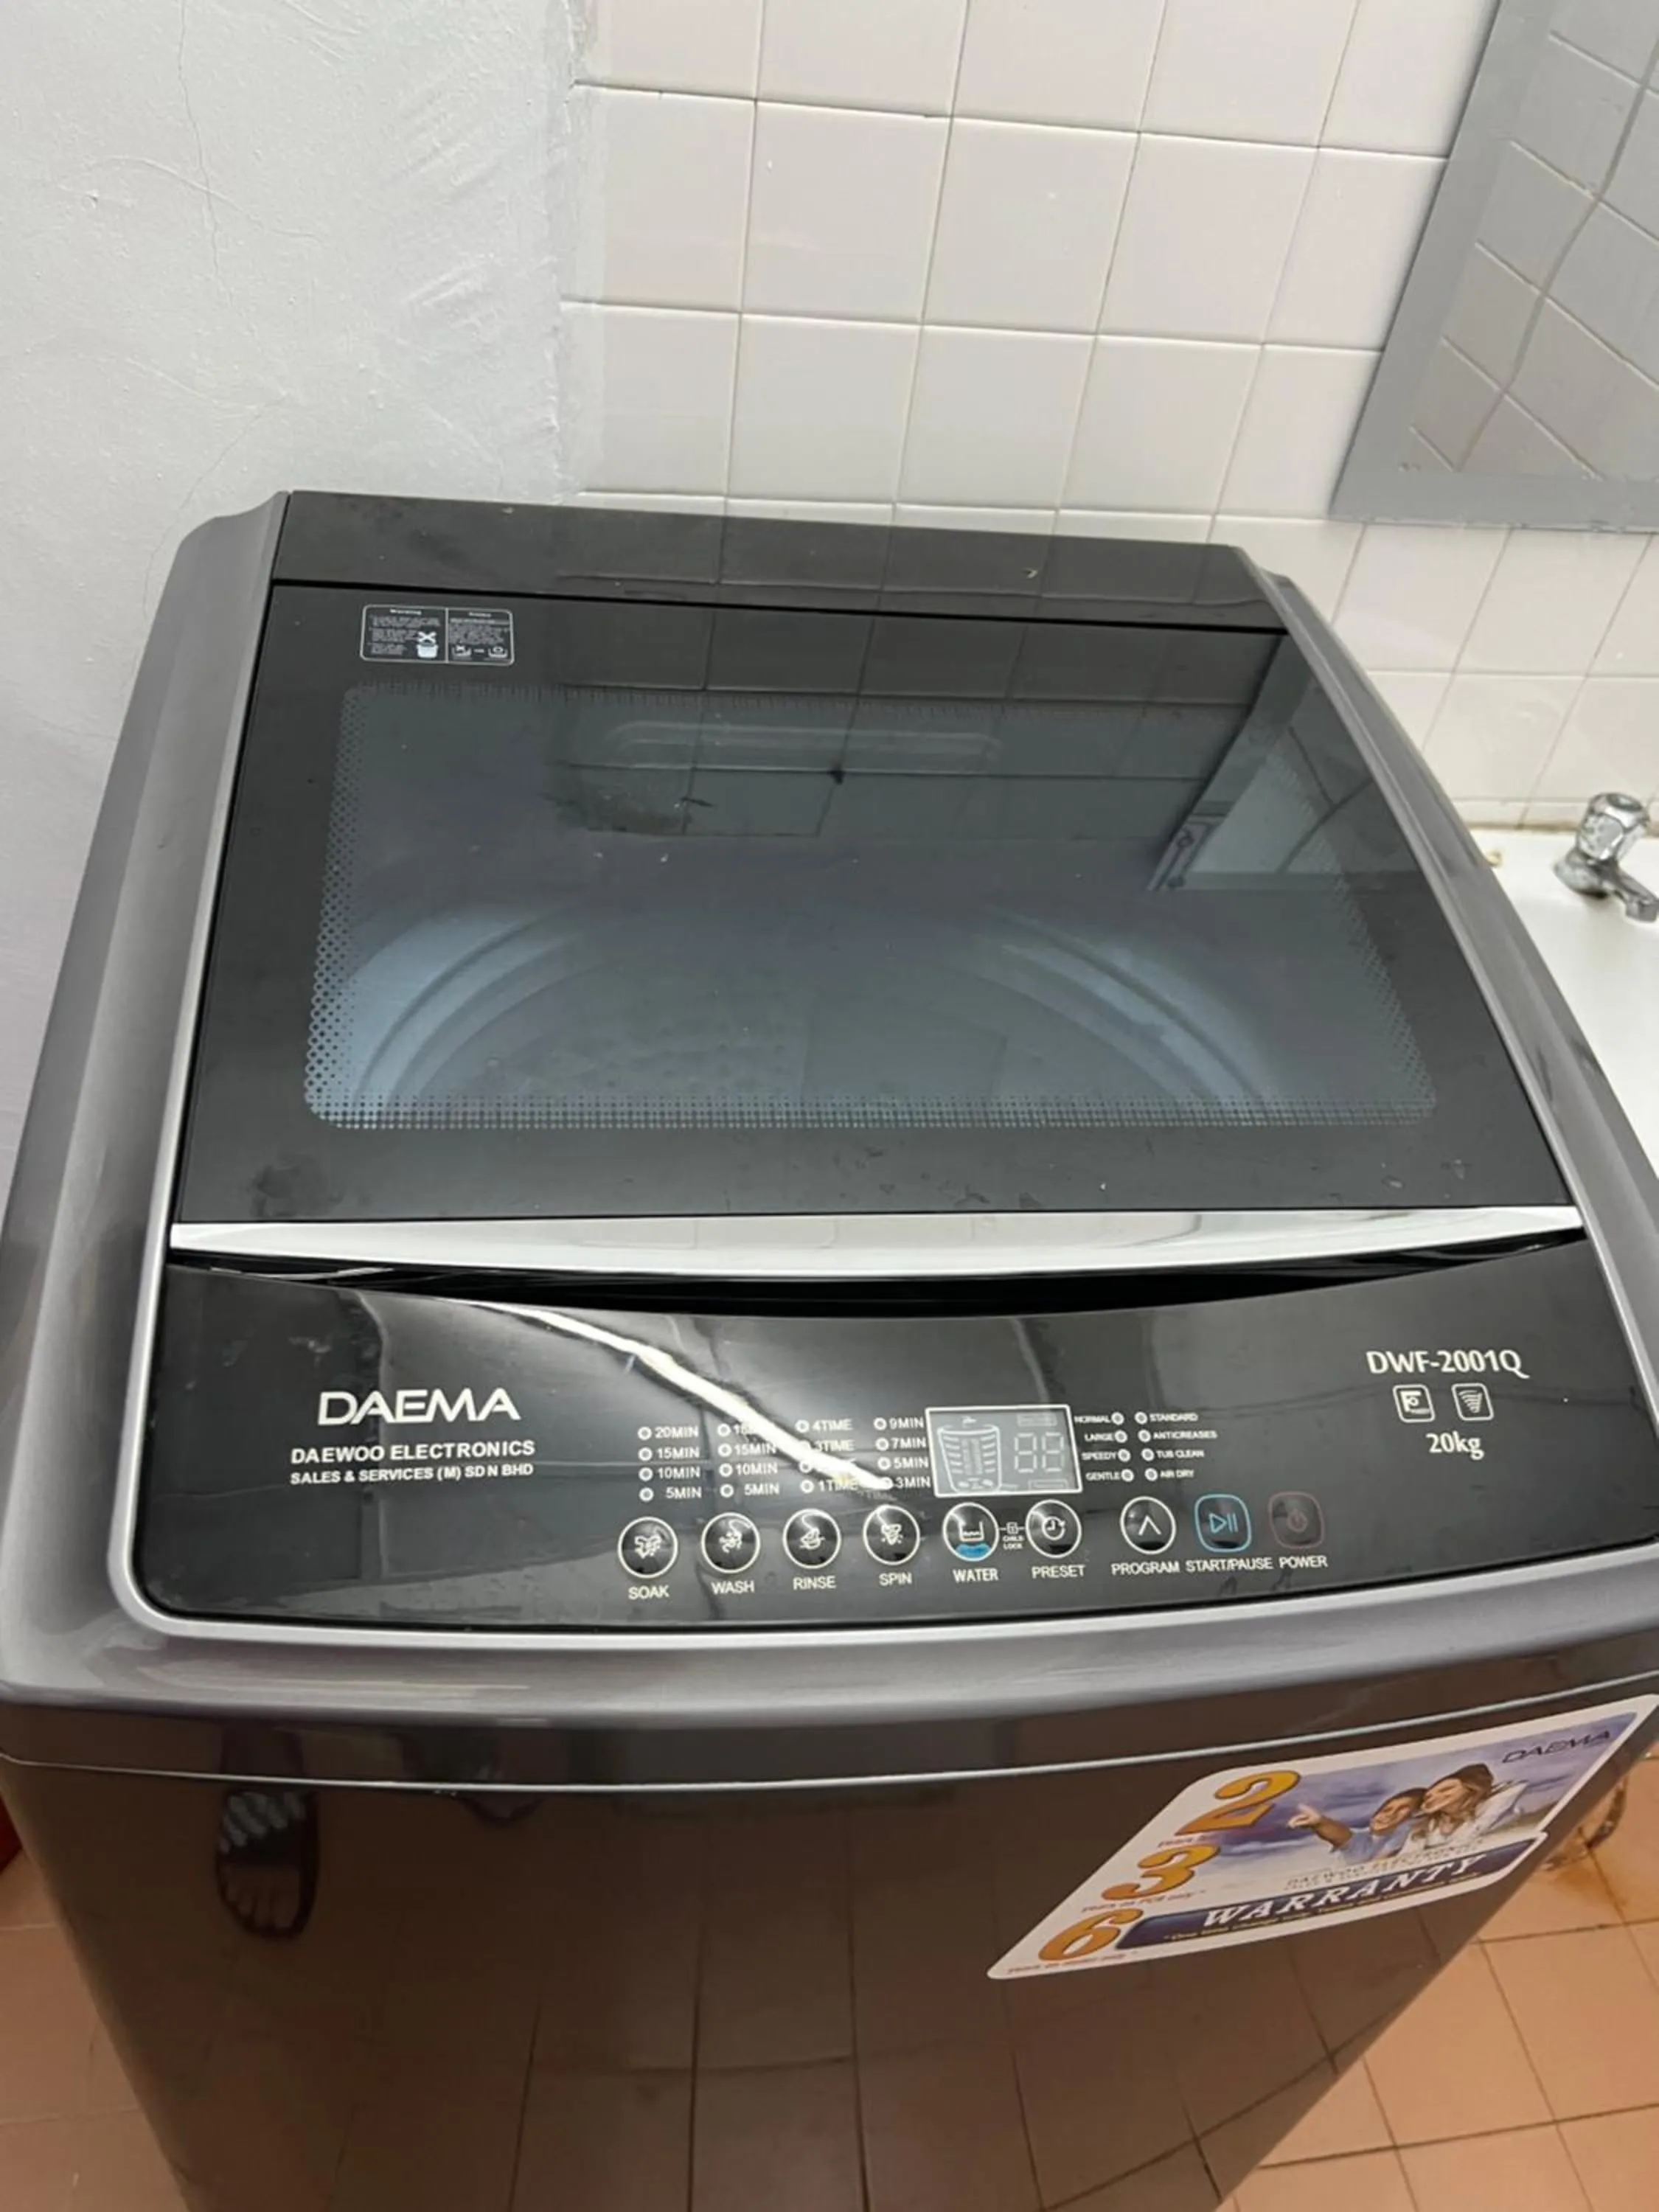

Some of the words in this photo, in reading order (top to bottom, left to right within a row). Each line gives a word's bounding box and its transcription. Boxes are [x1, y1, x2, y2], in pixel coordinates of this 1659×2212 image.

[1366, 1349, 1530, 1379] DWF-2001Q
[318, 1387, 521, 1425] DAEMA
[888, 1416, 924, 1429] 9MIN
[1074, 1415, 1111, 1424] NORMAL
[1150, 1412, 1199, 1422] STANDARD
[812, 1419, 853, 1432] 4TIME
[655, 1426, 699, 1439] 20MIN
[1152, 1430, 1218, 1439] ANTICREASES
[734, 1444, 776, 1456] 15MIN
[891, 1437, 926, 1450] 7MIN
[1425, 1430, 1485, 1460] 20kg
[291, 1445, 385, 1464] DAEWOO
[390, 1440, 535, 1461] ELECTRONICS
[656, 1447, 700, 1460] 15MIN
[1081, 1451, 1117, 1461] SPEEDY
[1175, 1450, 1205, 1458] CLEAN
[735, 1464, 778, 1475] 10MIN
[894, 1457, 929, 1470] 5MIN
[291, 1470, 341, 1484] SALES
[344, 1471, 355, 1482] &
[359, 1467, 434, 1482] SERVICES
[437, 1466, 462, 1481] (M)
[465, 1464, 498, 1478] SDN
[501, 1464, 534, 1475] BHD
[658, 1467, 700, 1479] 10MIN
[1085, 1472, 1121, 1481] GENTLE
[1159, 1470, 1175, 1478] AIR
[1176, 1469, 1194, 1478] DRY
[896, 1476, 931, 1489] 3MIN
[666, 1486, 702, 1499] 5MIN
[744, 1484, 780, 1495] 5MIN
[1110, 1560, 1180, 1576] PROGRAM
[1185, 1557, 1274, 1573] START/PAUSE
[1279, 1554, 1329, 1569] POWER
[953, 1568, 999, 1583] WATER
[1032, 1564, 1086, 1579] PRESET
[793, 1576, 837, 1591] RINSE
[879, 1573, 913, 1587] SPIN
[627, 1585, 669, 1599] SOAK
[711, 1580, 755, 1596] WASH
[1174, 1770, 1302, 1837] 2
[1100, 1844, 1222, 1902] 3
[1202, 1854, 1488, 1927] WARRANTY
[1037, 1907, 1144, 1961] 6
